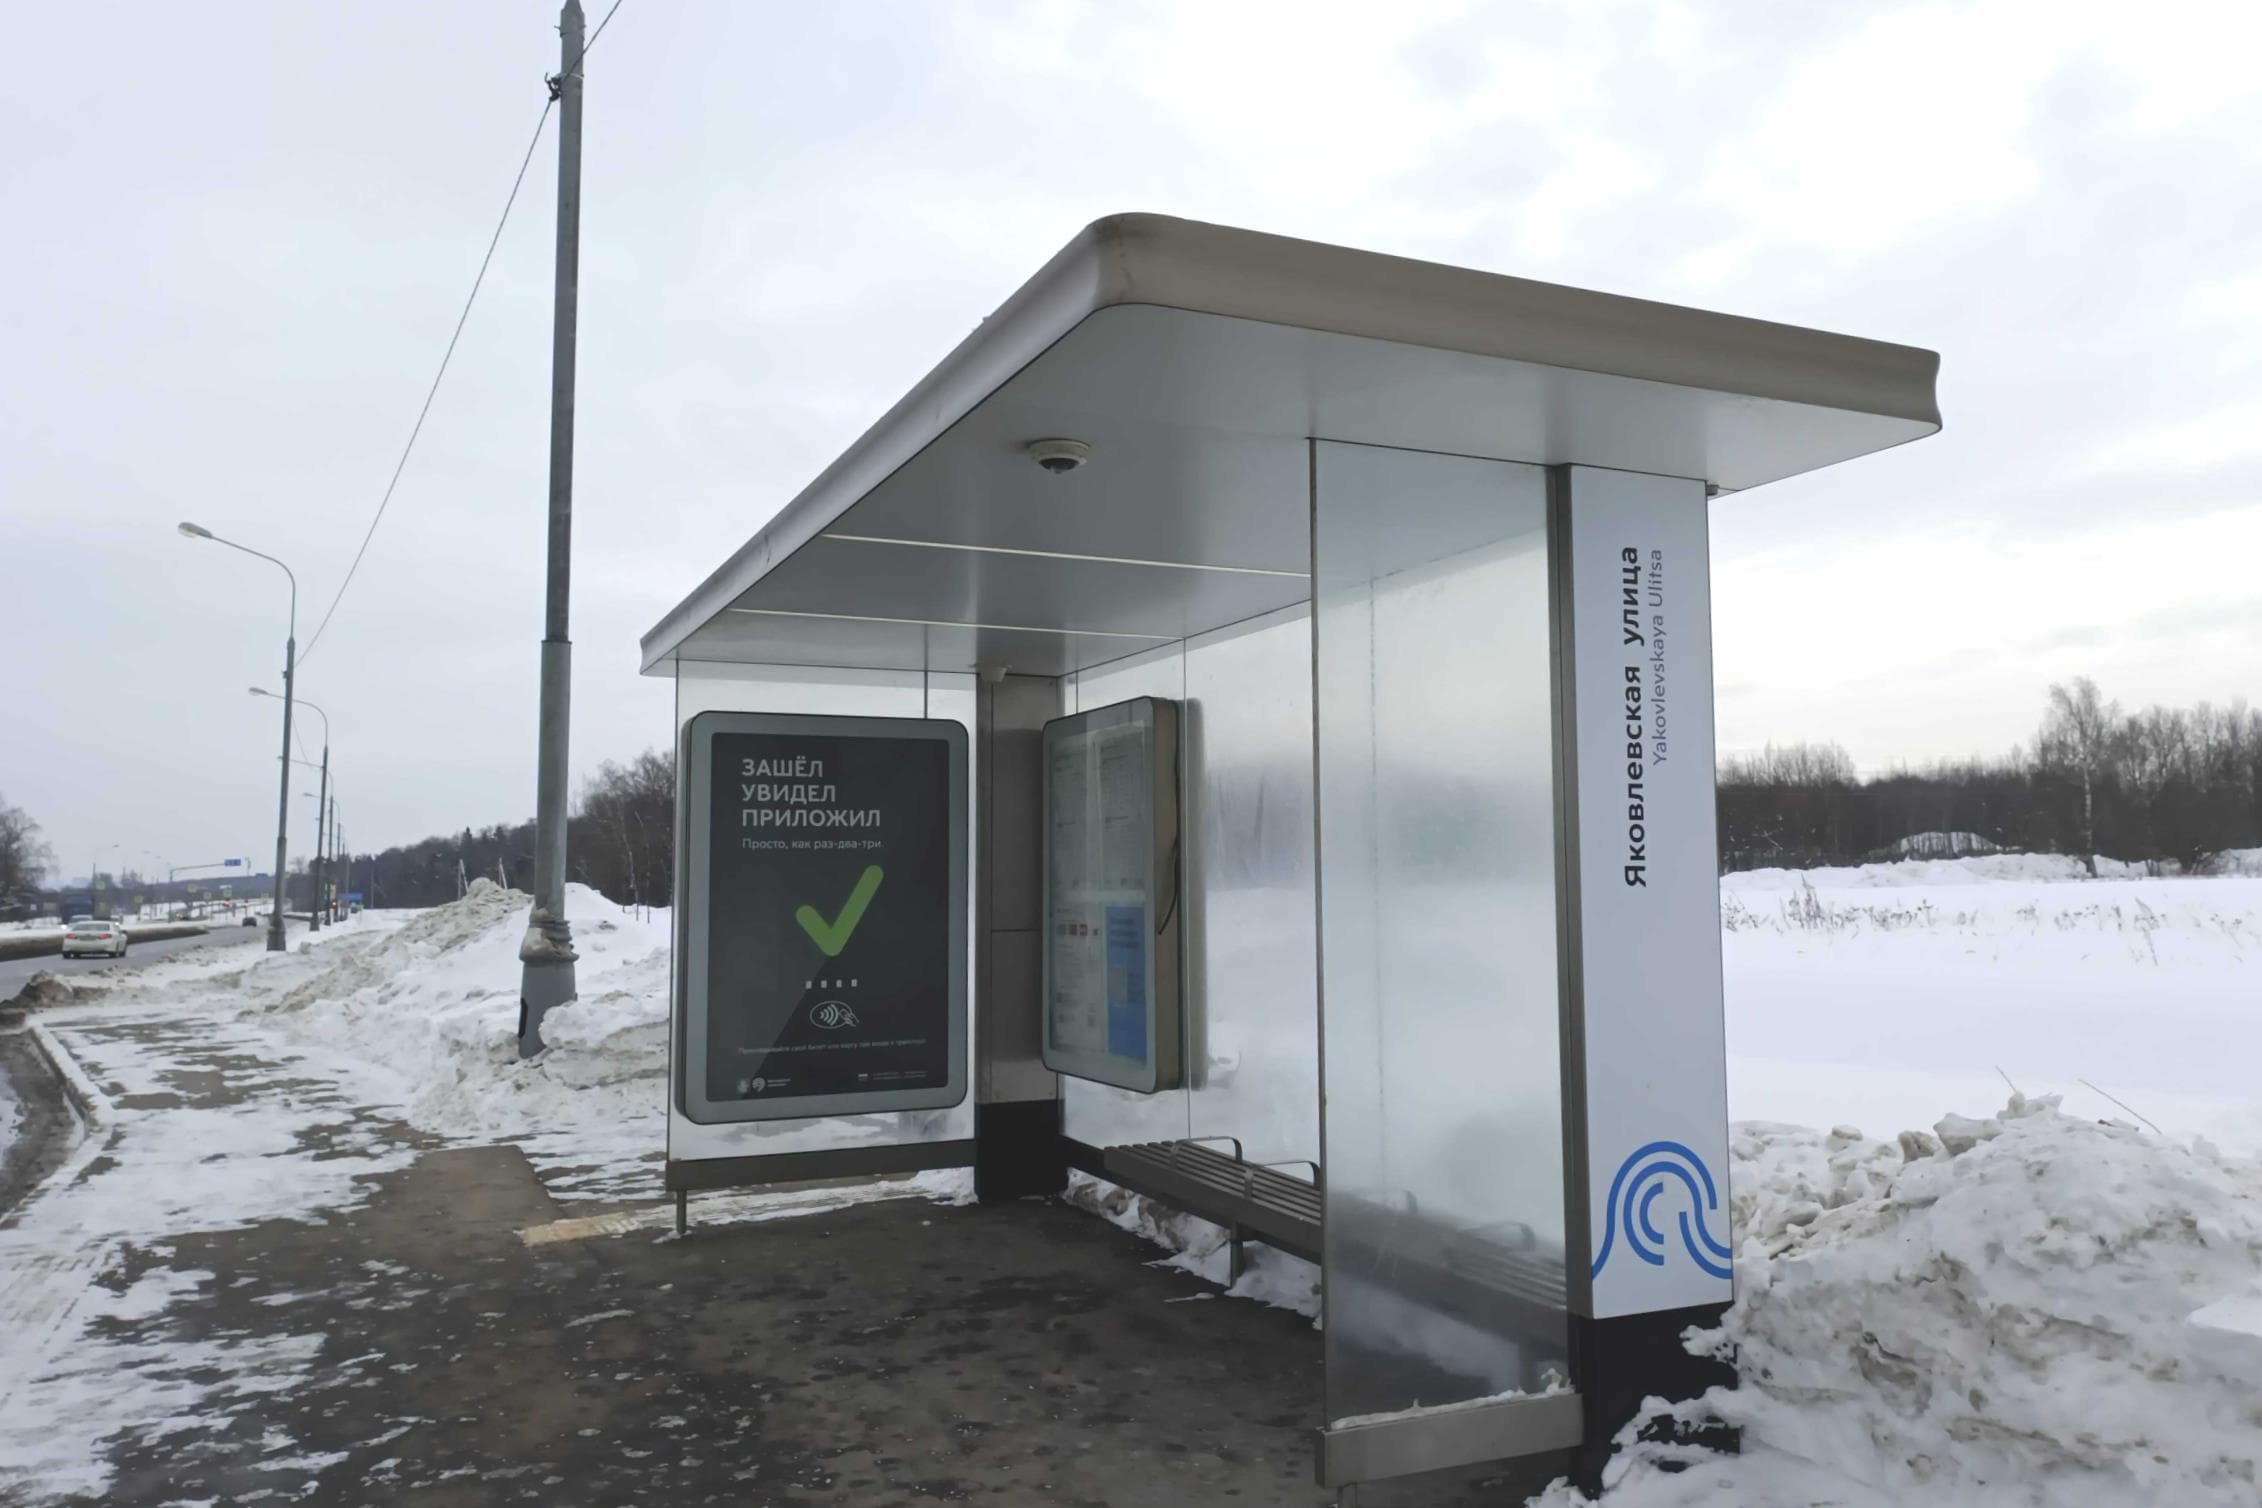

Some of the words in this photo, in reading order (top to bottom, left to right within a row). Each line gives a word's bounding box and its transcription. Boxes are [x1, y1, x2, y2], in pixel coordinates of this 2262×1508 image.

[1621, 547, 1645, 647] улица
[1647, 549, 1664, 608] Ulitsa
[1649, 615, 1667, 766] Yakovlevskaya
[741, 755, 823, 778] ЗАШЁЛ
[1624, 666, 1647, 888] Яковлевская
[741, 783, 836, 805] УВИДЕЛ
[742, 809, 881, 827] ПРИЛОЖИЛ
[741, 837, 789, 851] Просто,
[791, 839, 812, 850] как
